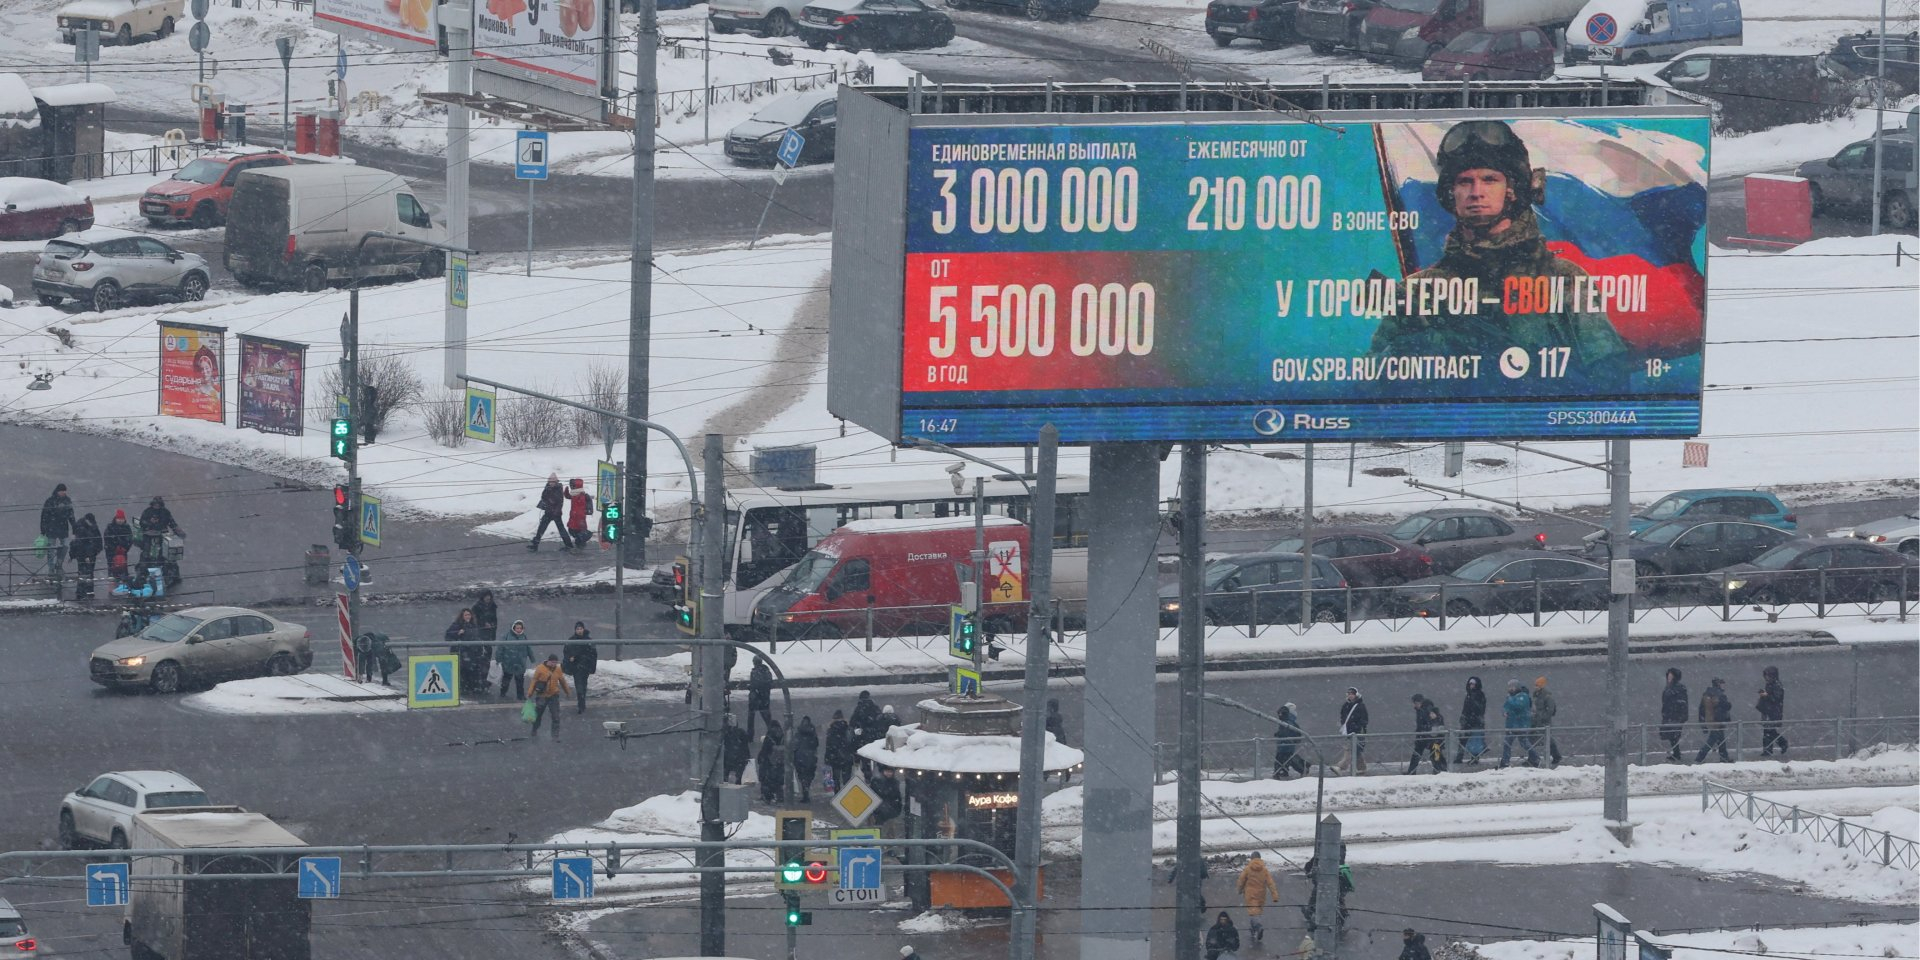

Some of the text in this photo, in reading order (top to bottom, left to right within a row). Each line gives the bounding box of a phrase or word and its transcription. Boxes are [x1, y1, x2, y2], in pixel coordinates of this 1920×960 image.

[478, 14, 508, 34] Морковь
[539, 28, 552, 46] Лук
[552, 37, 586, 53] репчатый
[932, 142, 1137, 164] ЕДИНОВРЕМЕННАЯ ВЫПЛАТА
[1188, 140, 1308, 159] ЕЖЕМЕСЯЧНО ОТ
[932, 166, 1139, 234] 3 000 000
[1187, 174, 1419, 231] 210 000 В ЗОНЕ СВО
[931, 259, 951, 278] ОТ
[1276, 280, 1293, 318] У
[1307, 277, 1479, 319] ГОРОДА-ГЕРОЯ
[1503, 276, 1564, 316] СВОИ
[1574, 274, 1647, 313] ГЕРОИ
[929, 282, 1155, 358] 5 500 000
[1272, 354, 1482, 382] GOV.SPB.RU/CONTRACT
[1538, 347, 1571, 378] 117
[1645, 359, 1672, 378] 18+
[928, 365, 968, 385] В ГОД
[919, 418, 958, 433] 16:47
[1294, 415, 1351, 430] Russ
[1547, 410, 1638, 426] SPSS30044A
[335, 423, 348, 435] 26
[606, 507, 619, 519] 26
[907, 552, 948, 562] Доставка
[968, 793, 1018, 807] Аура Кофе
[835, 889, 878, 903] СТОП
